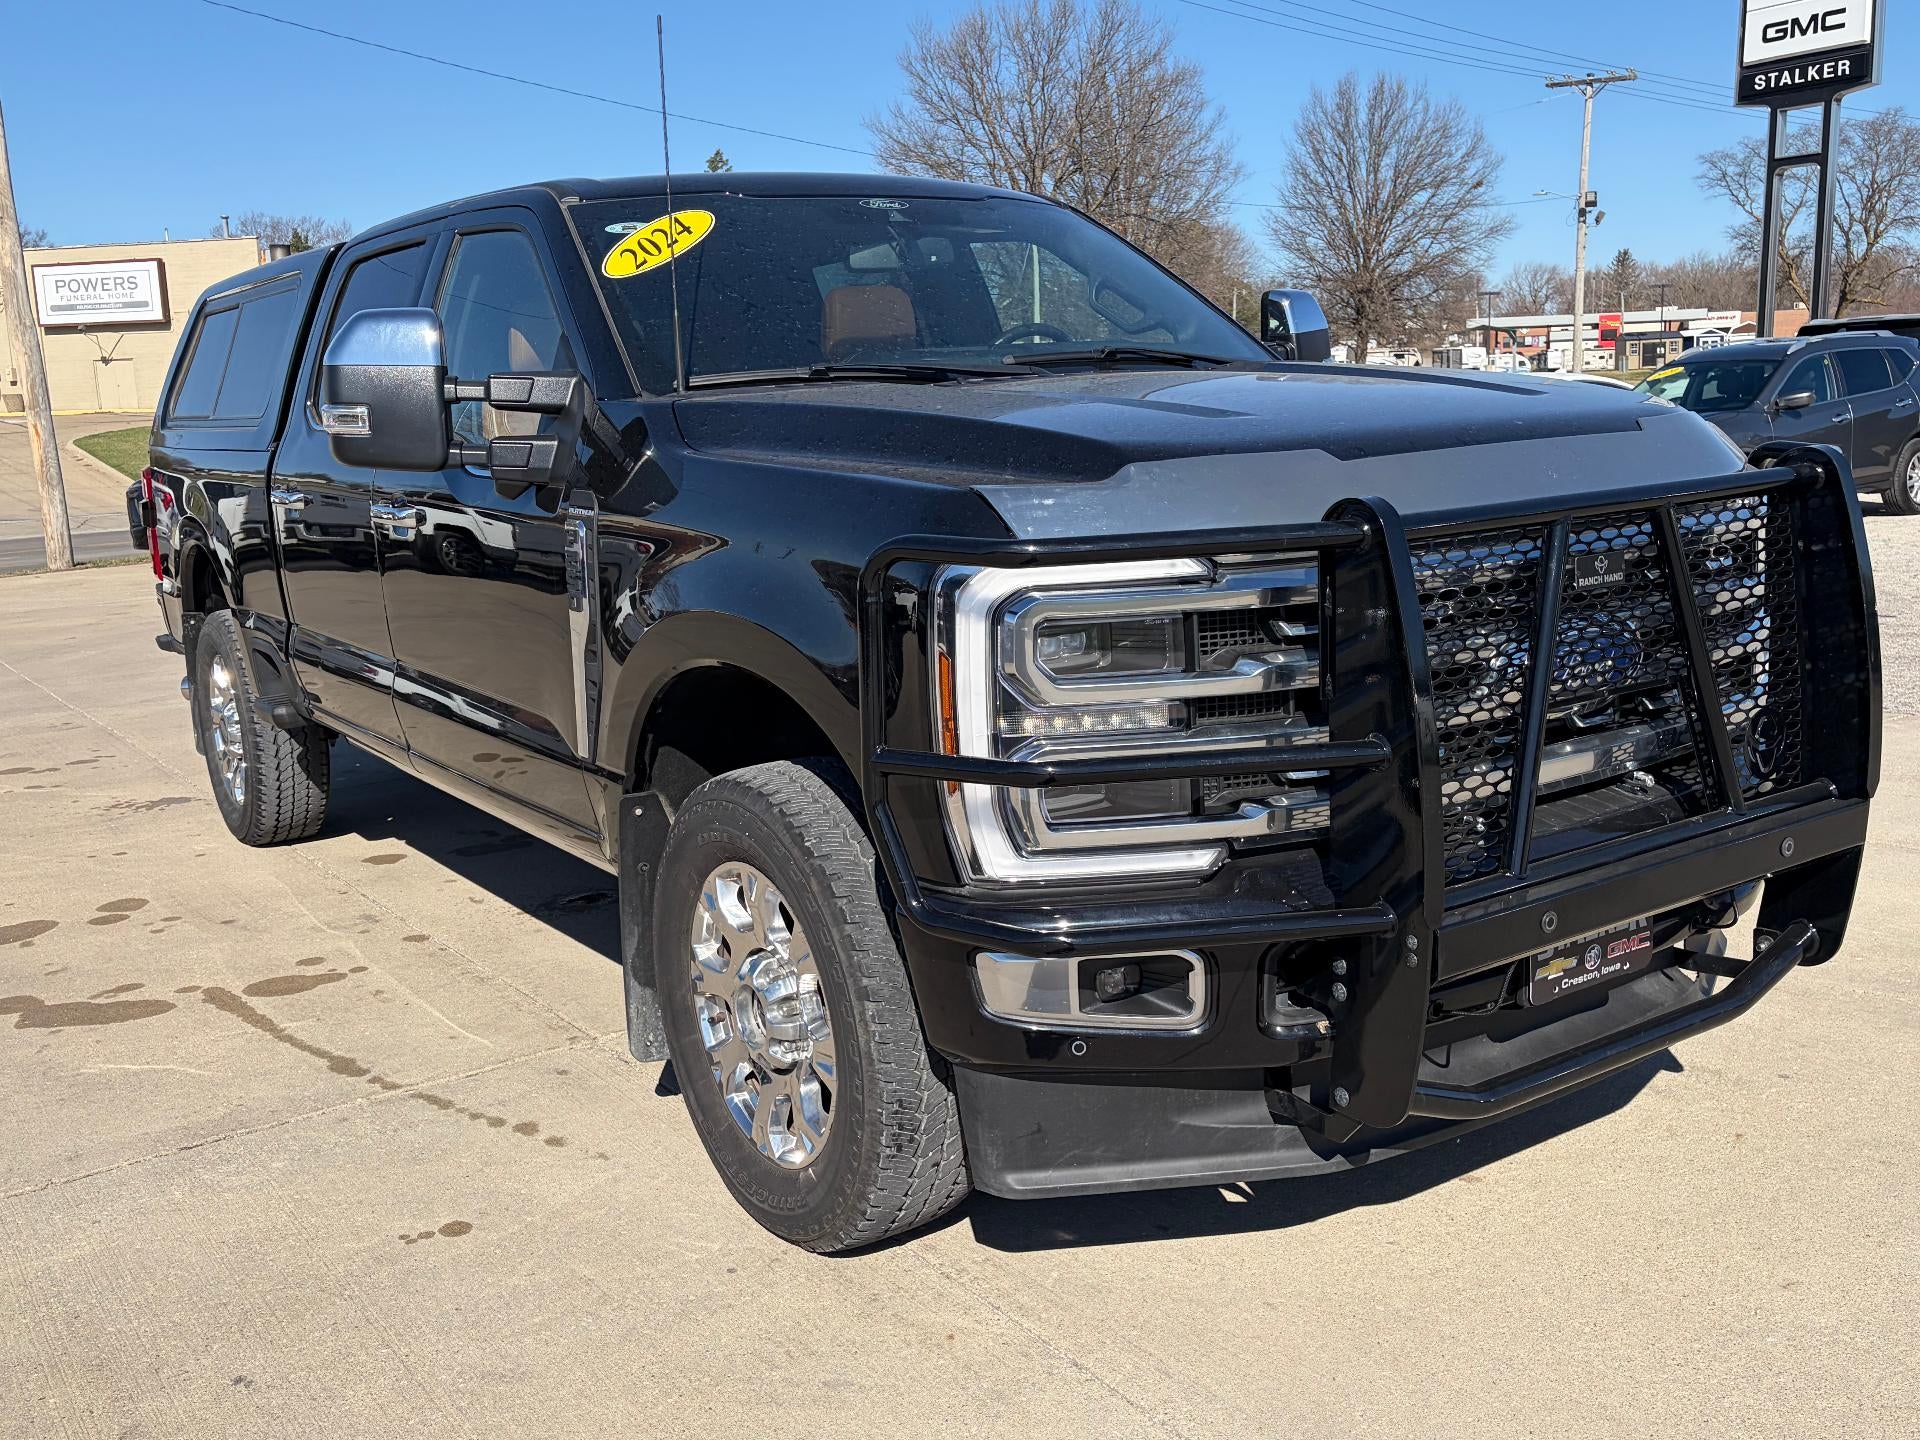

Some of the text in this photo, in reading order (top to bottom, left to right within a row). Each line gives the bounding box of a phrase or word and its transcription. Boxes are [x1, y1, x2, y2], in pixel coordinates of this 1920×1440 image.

[1762, 7, 1846, 43] GMC
[1754, 60, 1850, 90] STALKER
[619, 216, 694, 270] 2024
[55, 276, 138, 294] POWERS
[60, 292, 135, 302] FUNERAL HOME
[1578, 572, 1623, 587] RANCH HAND
[1607, 931, 1650, 958] GMC
[1562, 963, 1621, 989] Creston, Iowa
